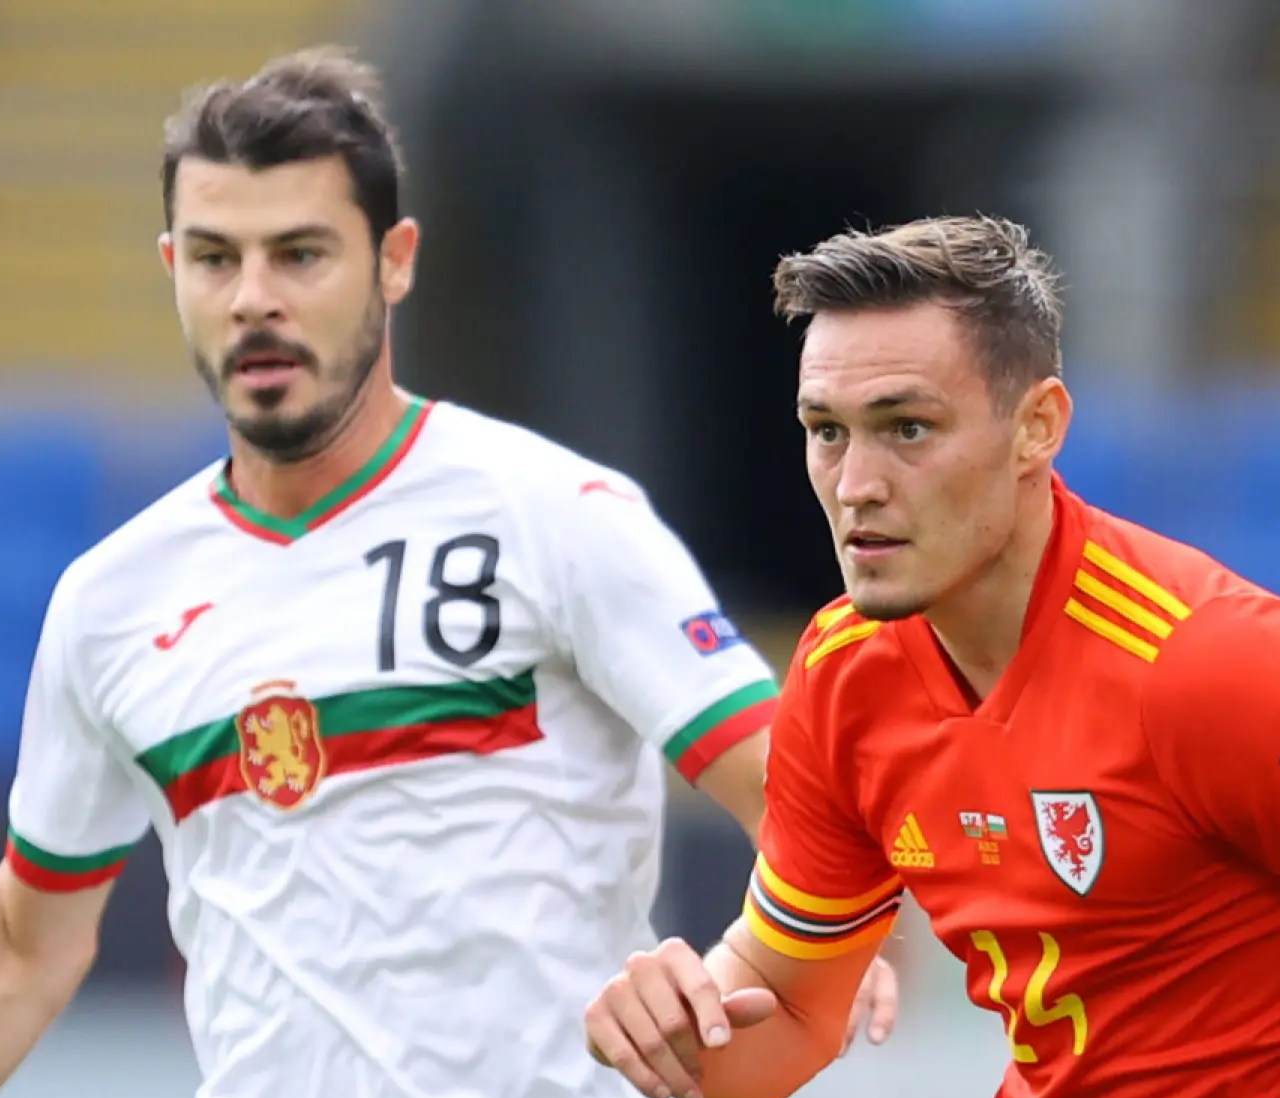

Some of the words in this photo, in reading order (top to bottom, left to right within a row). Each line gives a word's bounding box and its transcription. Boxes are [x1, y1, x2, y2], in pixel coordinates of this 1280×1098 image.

[364, 533, 501, 671] 18
[890, 849, 935, 868] adidas
[970, 929, 1088, 1063] 14
